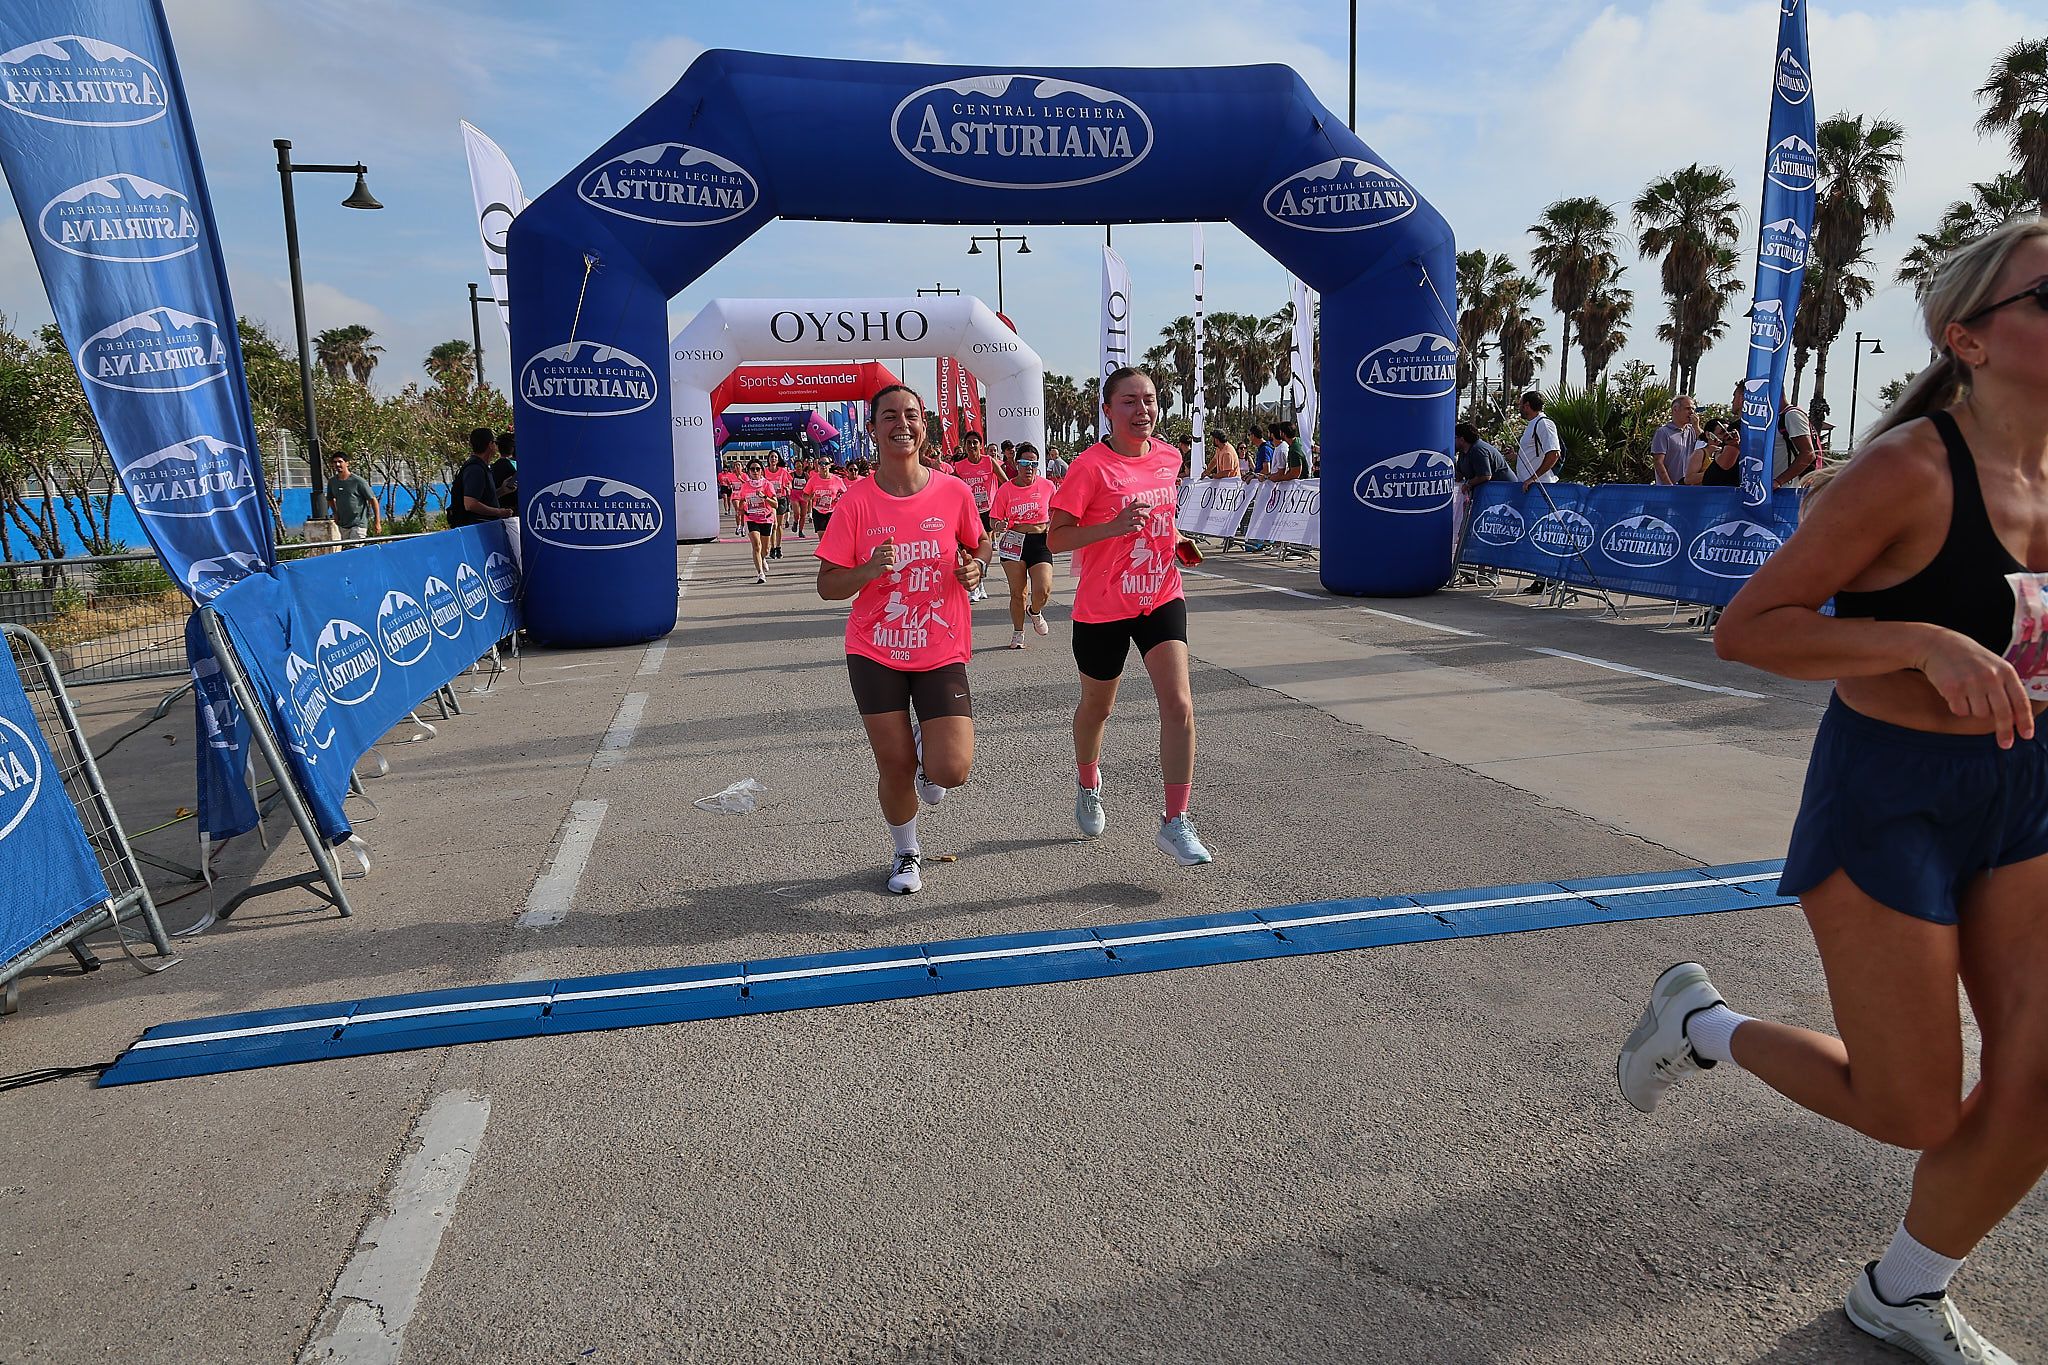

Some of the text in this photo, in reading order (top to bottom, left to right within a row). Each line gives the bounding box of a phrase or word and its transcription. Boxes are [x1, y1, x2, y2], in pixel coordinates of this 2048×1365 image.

[952, 103, 1126, 119] CENTRAL LECHERA
[911, 104, 1134, 158] ASTURIANA
[1769, 153, 1815, 180] ASTURIANA
[620, 168, 743, 185] CENTRAL LECHERA
[589, 171, 745, 209] ASTURIANA
[1303, 181, 1401, 194] CENTRAL LECHERA
[1276, 189, 1411, 216] ASTURIANA
[770, 310, 928, 343] OYSHO
[674, 350, 724, 361] OYSHO
[972, 342, 1018, 354] OYSHO
[1388, 355, 1431, 364] CENTRAL
[543, 366, 646, 378] CENTRAL LECHERA
[527, 369, 651, 400] ASTURIANA
[739, 373, 857, 389] Sports Santander
[998, 406, 1040, 419] OYSHO
[672, 416, 703, 427] SHO
[1385, 472, 1427, 480] CENTRAL
[550, 501, 651, 509] CENTRAL LECHERA
[1201, 486, 1245, 512] OYSHO
[534, 503, 656, 530] ASTURIANA
[867, 525, 896, 536] OYSHO
[1605, 532, 1673, 557] ASTURIANA
[1139, 595, 1153, 606] 202
[382, 617, 430, 656] ASTURIANA
[873, 628, 928, 649] MUJER
[890, 649, 910, 660] 2026
[322, 647, 378, 693] ASTURIANA
